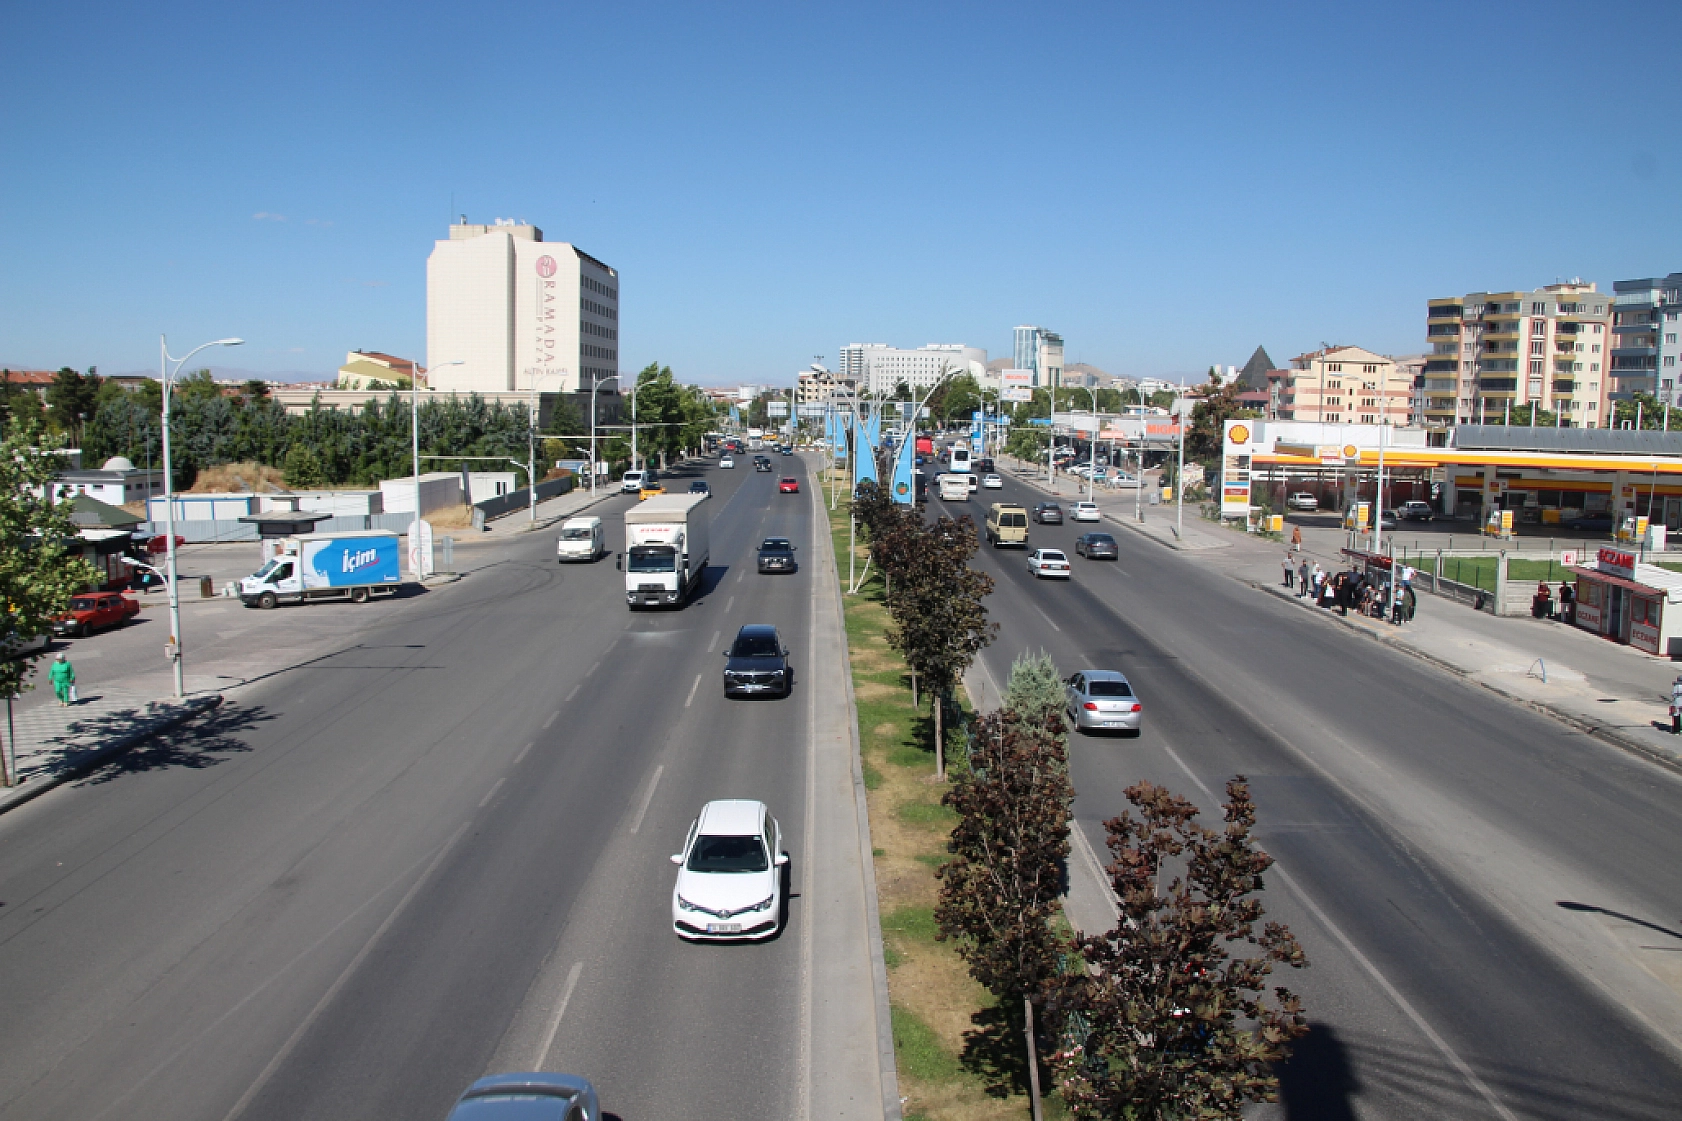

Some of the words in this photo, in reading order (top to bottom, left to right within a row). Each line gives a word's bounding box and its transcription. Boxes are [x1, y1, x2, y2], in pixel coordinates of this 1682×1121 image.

[544, 281, 556, 362] RAMADA
[1599, 548, 1635, 570] ECZANE
[1632, 628, 1657, 646] ECZANE
